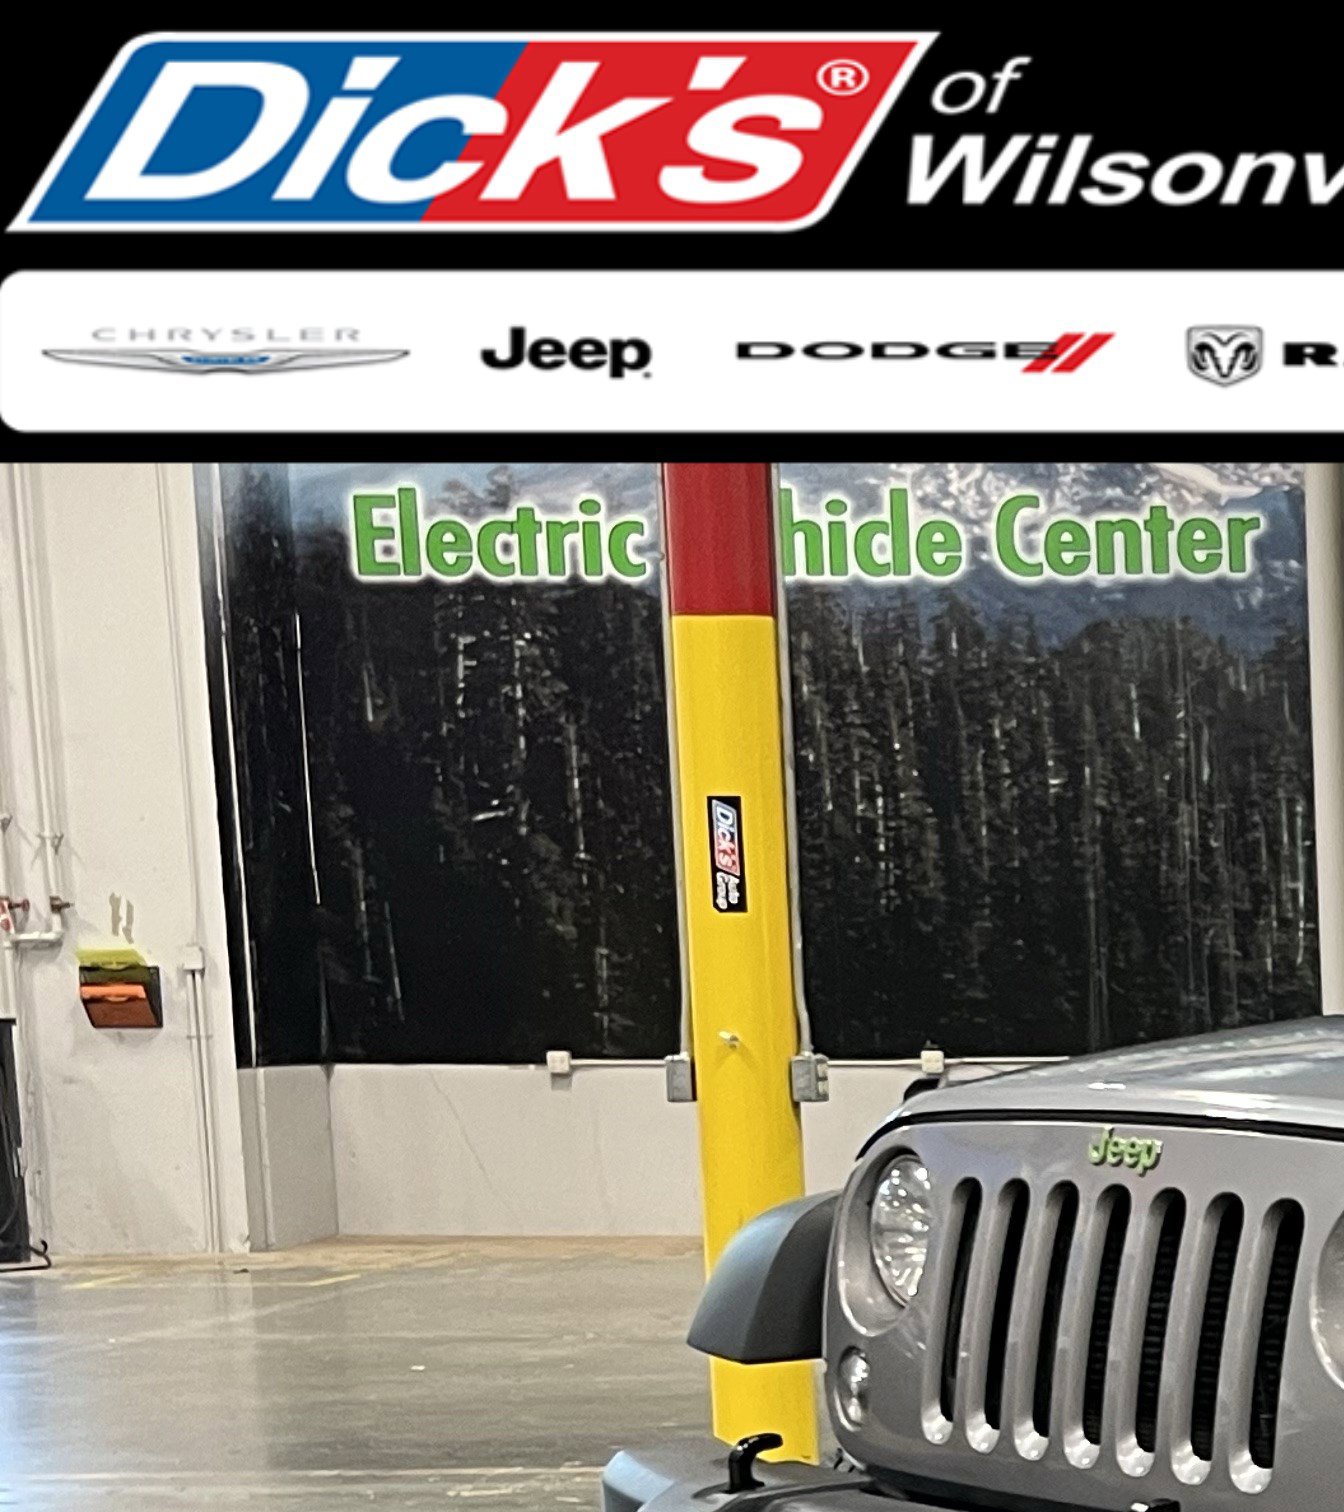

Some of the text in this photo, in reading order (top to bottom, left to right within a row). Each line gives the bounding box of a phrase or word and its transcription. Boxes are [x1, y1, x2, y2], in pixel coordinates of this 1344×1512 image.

[353, 487, 1261, 577] Electric hicle Center
[1088, 1125, 1163, 1176] Jeep
